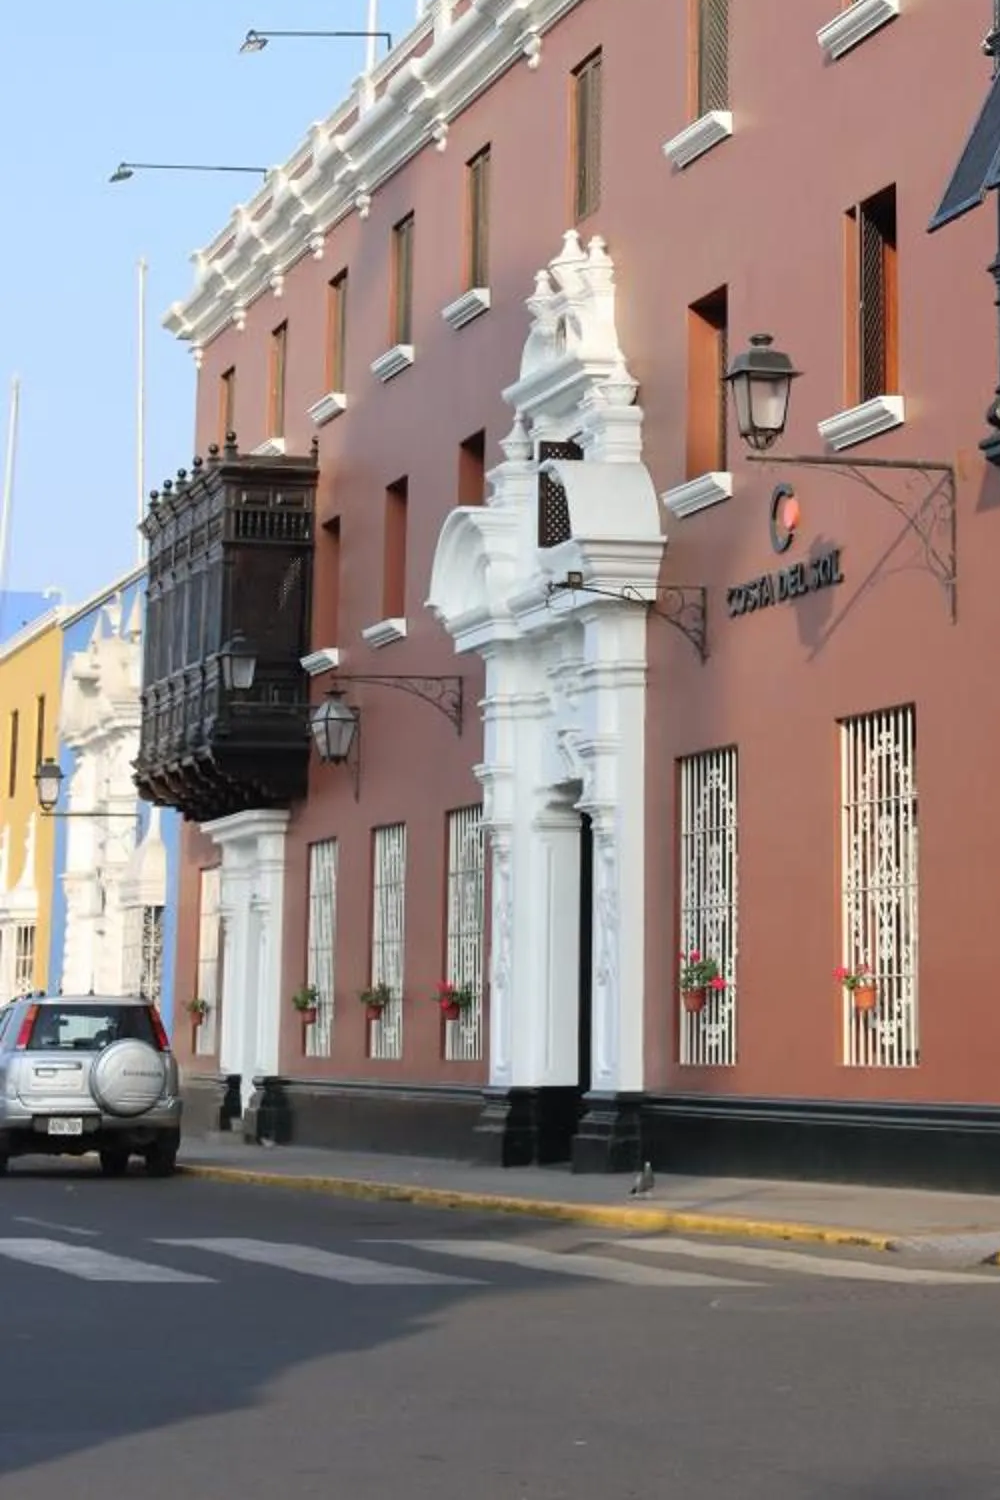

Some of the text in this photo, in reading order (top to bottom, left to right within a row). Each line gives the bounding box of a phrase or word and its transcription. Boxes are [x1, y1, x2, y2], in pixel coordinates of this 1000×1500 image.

[726, 548, 845, 619] COSTA DEL SOL
